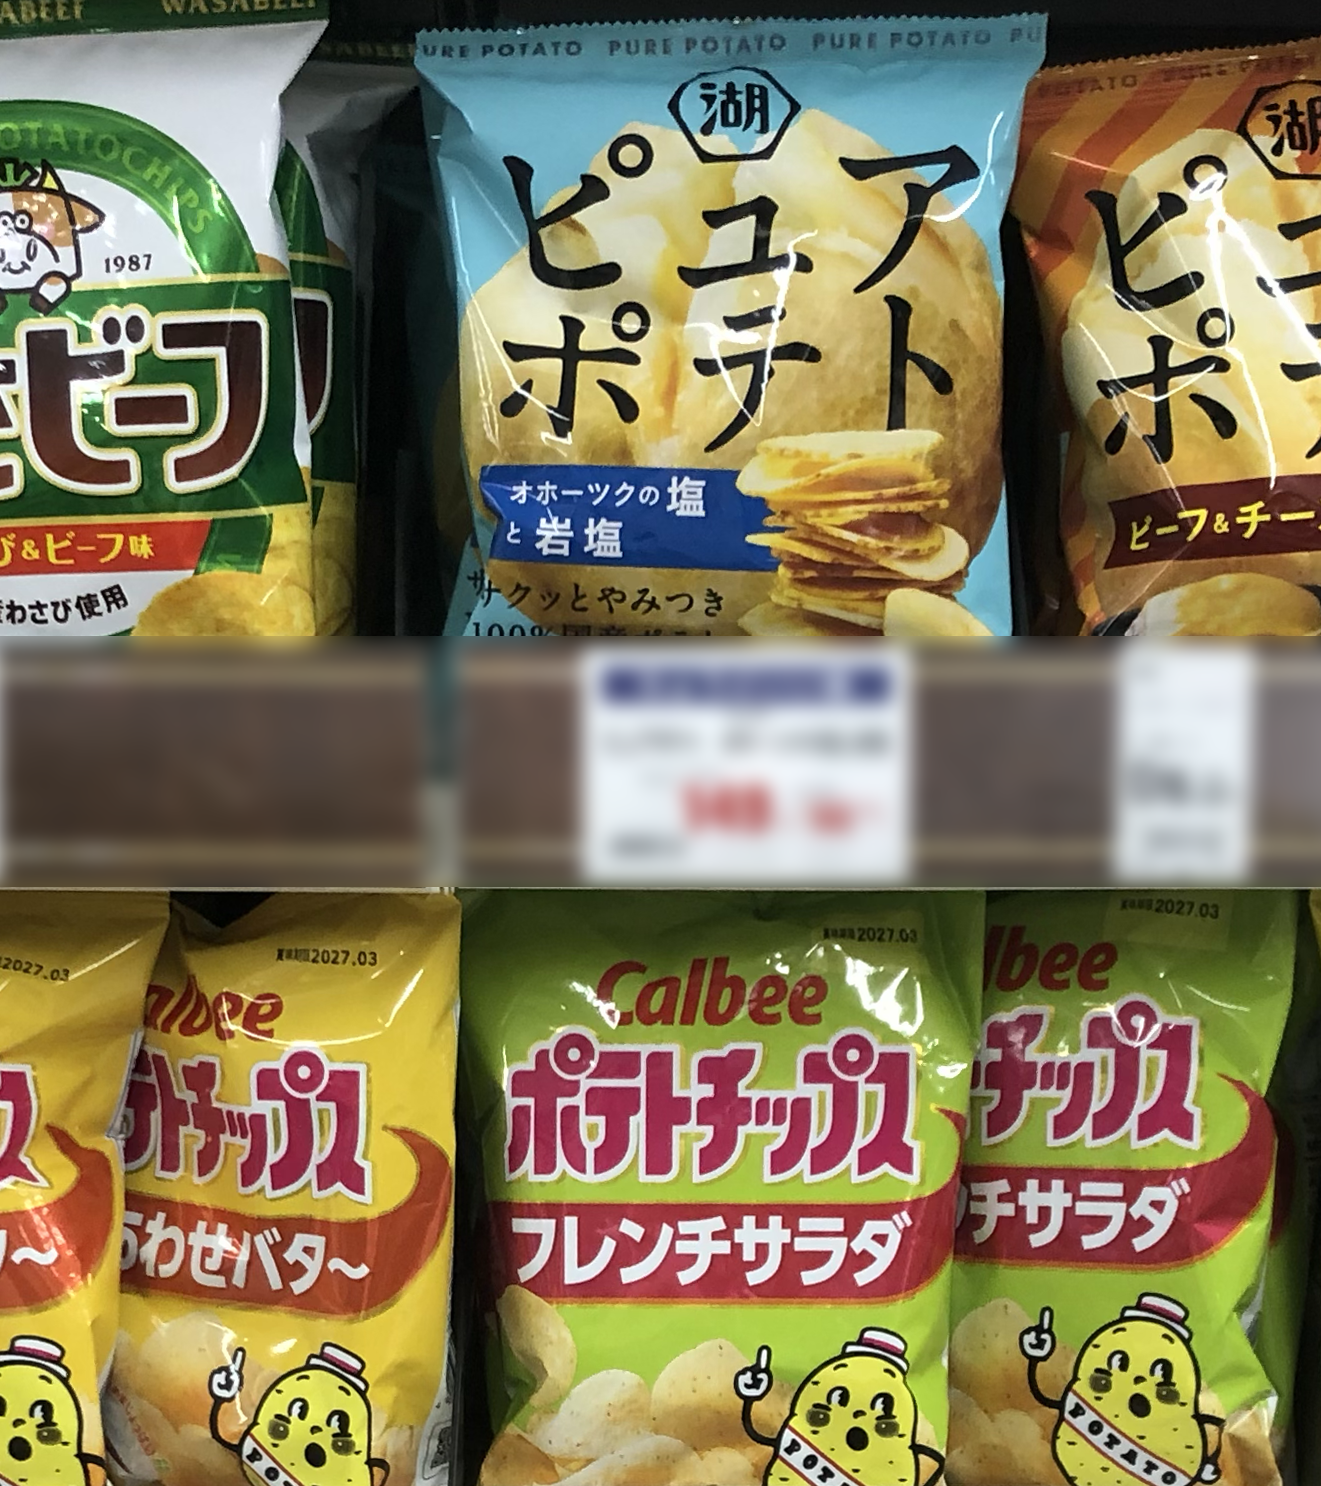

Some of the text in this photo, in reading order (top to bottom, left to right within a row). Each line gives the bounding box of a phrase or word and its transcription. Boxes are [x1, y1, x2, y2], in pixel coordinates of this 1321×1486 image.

[609, 38, 674, 57] PURE
[686, 34, 787, 56] POTATO
[503, 133, 981, 293] ピュア
[104, 254, 152, 274] 1987
[499, 295, 954, 454] ポテト
[510, 475, 707, 517] オホーツクの塩
[505, 518, 624, 559] と岩塩
[466, 571, 726, 619] サクッとやみつき
[596, 957, 828, 1027] Calbee
[506, 1028, 919, 1184] ポテトチップス
[511, 1212, 912, 1286] フレンチサラダ
[1069, 1401, 1177, 1486] POTATO
